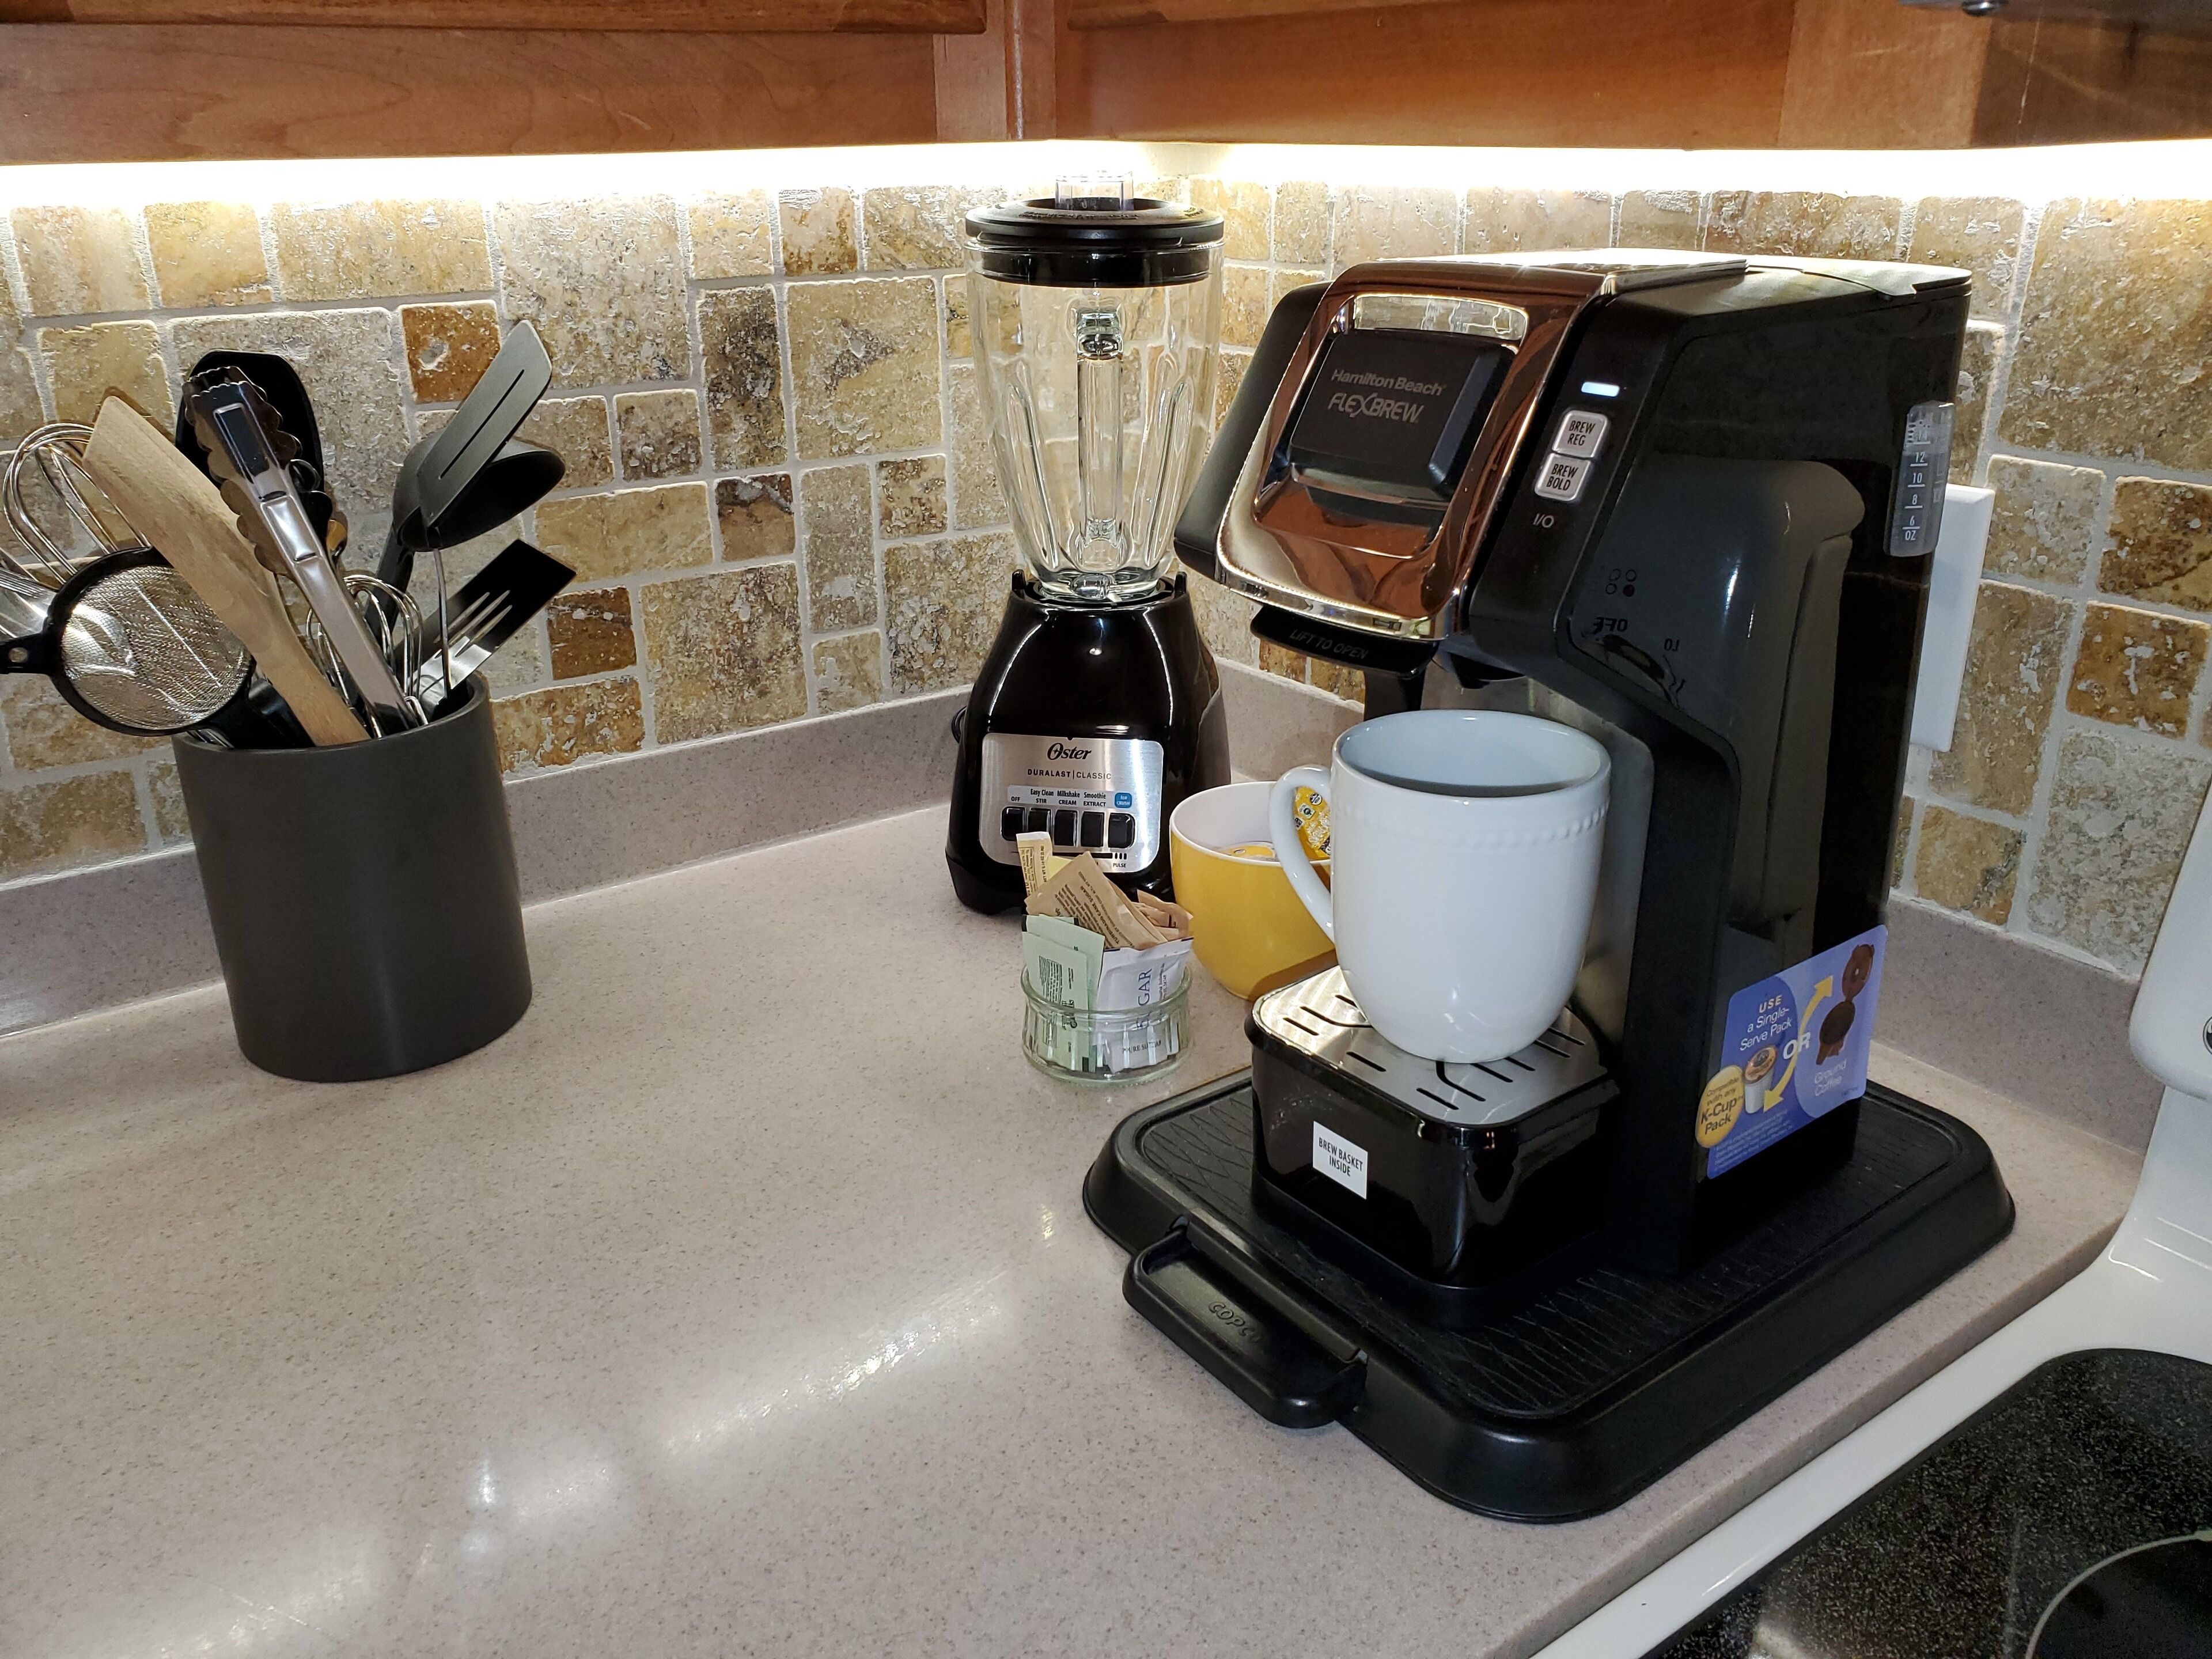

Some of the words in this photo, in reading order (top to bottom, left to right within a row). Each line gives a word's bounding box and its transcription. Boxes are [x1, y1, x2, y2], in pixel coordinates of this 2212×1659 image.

[1331, 369, 1395, 389] Hamilton
[1394, 377, 1443, 396] Beach
[1327, 392, 1425, 423] FLEXBREW
[1569, 420, 1596, 434] BREW
[1567, 433, 1586, 446] REG
[1915, 452, 1925, 463] 12
[1551, 463, 1578, 479] BREW
[1912, 472, 1922, 483] 10
[1546, 476, 1571, 490] BOLD
[1912, 494, 1918, 505] 8
[1533, 513, 1554, 528] I/O
[1909, 515, 1915, 525] 6
[1905, 530, 1916, 541] OZ
[1290, 628, 1316, 644] LIFT
[1315, 637, 1333, 650] TO
[1333, 643, 1369, 660] OPEN
[1047, 743, 1092, 760] Oster
[1028, 768, 1071, 778] DURALAST
[1076, 771, 1112, 779] CLASSIC
[1031, 788, 1040, 797] Easy
[1057, 790, 1080, 798] Milkshake
[1759, 995, 1782, 1013] USE
[1740, 1032, 1768, 1051] Serve
[1771, 1017, 1791, 1037] Pack
[1748, 1024, 1753, 1033] a
[1783, 1032, 1810, 1059] OR
[1701, 1098, 1737, 1125] K-Cup
[1705, 1113, 1731, 1135] Pack
[1319, 1137, 1337, 1156] BREW
[1339, 1149, 1363, 1171] BASKET
[1330, 1156, 1351, 1177] INSIDE
